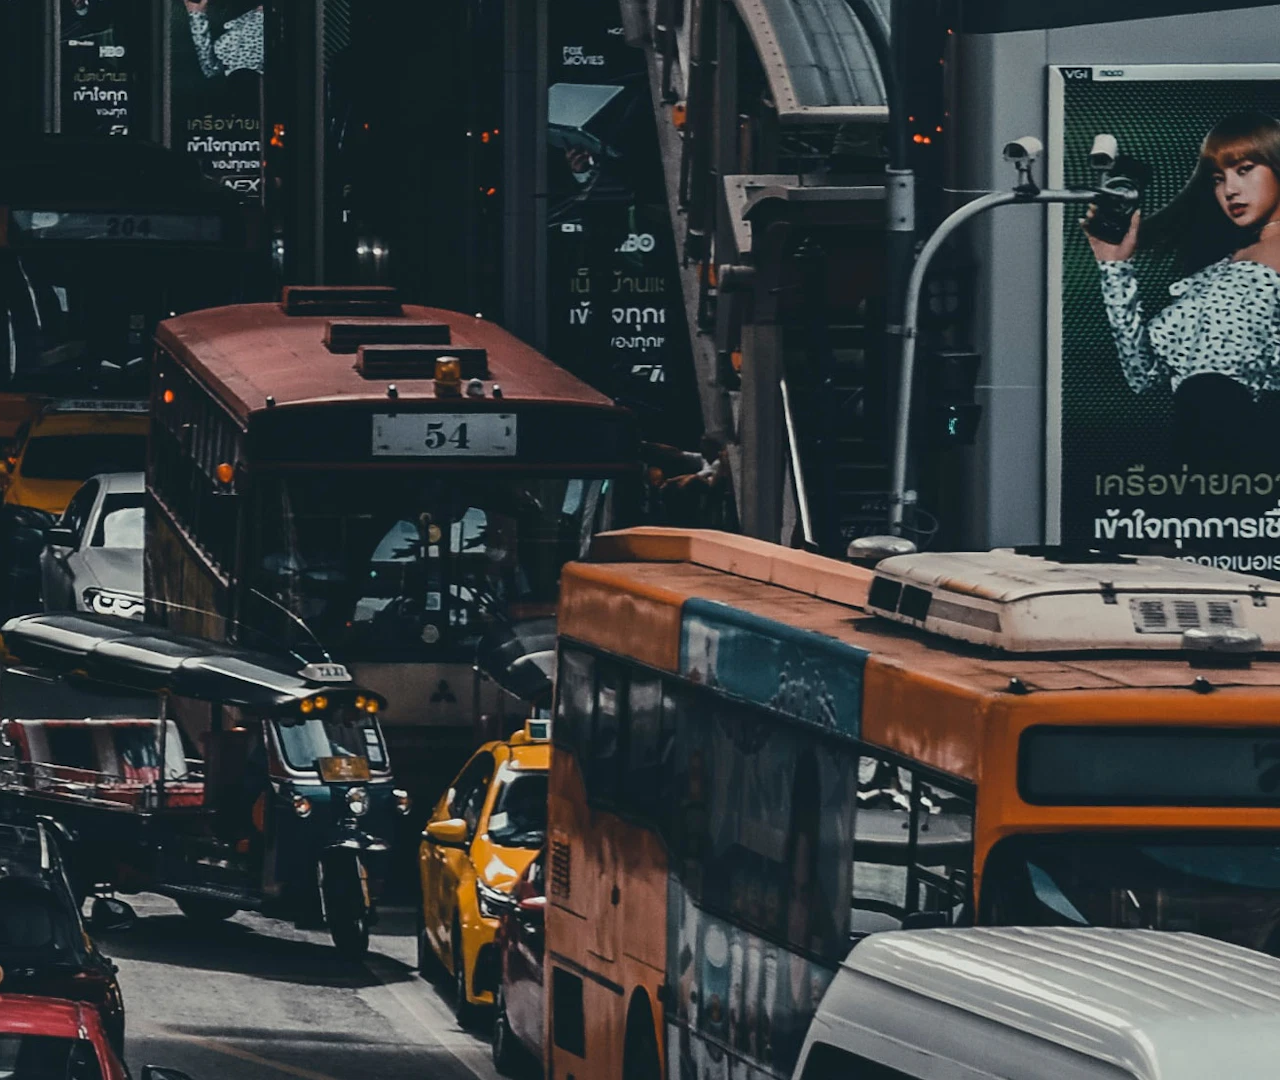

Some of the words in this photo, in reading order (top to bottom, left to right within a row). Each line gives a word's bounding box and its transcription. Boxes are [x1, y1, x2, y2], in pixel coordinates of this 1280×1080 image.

[1064, 70, 1089, 79] VGI
[107, 217, 152, 235] 204
[424, 421, 470, 450] 54
[319, 667, 345, 677] TAXI
